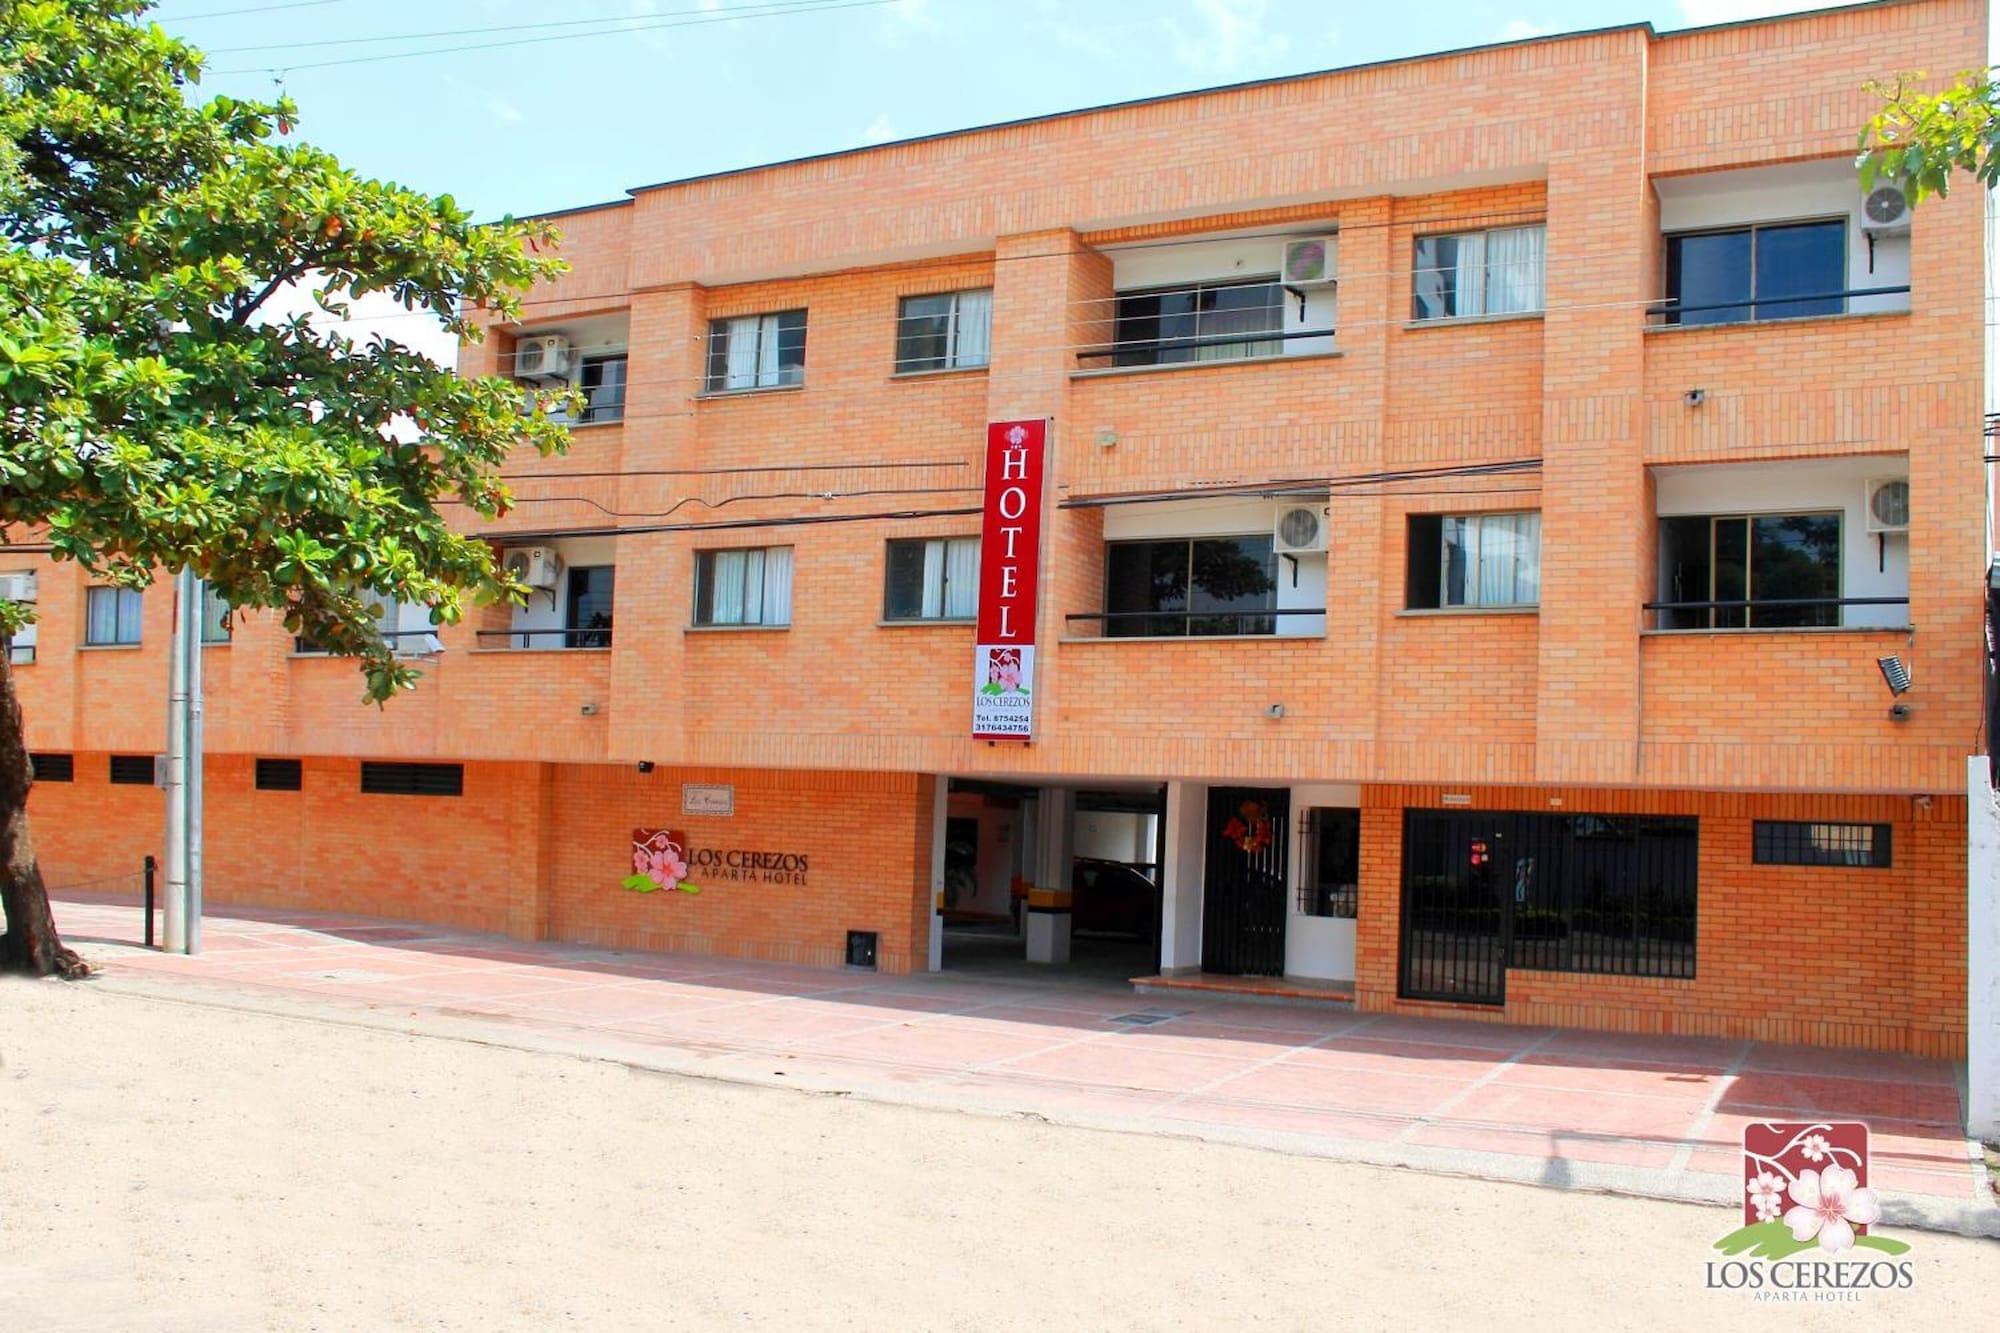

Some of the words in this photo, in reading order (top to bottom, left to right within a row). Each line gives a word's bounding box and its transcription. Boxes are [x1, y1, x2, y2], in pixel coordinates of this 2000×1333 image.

[1000, 448, 1029, 638] HOTEL
[977, 696, 992, 707] LOS
[993, 696, 1030, 707] CEREZOS
[688, 848, 722, 868] LOS
[726, 850, 808, 872] CEREZOS
[702, 867, 757, 882] APARTA
[763, 871, 807, 886] HOTEL
